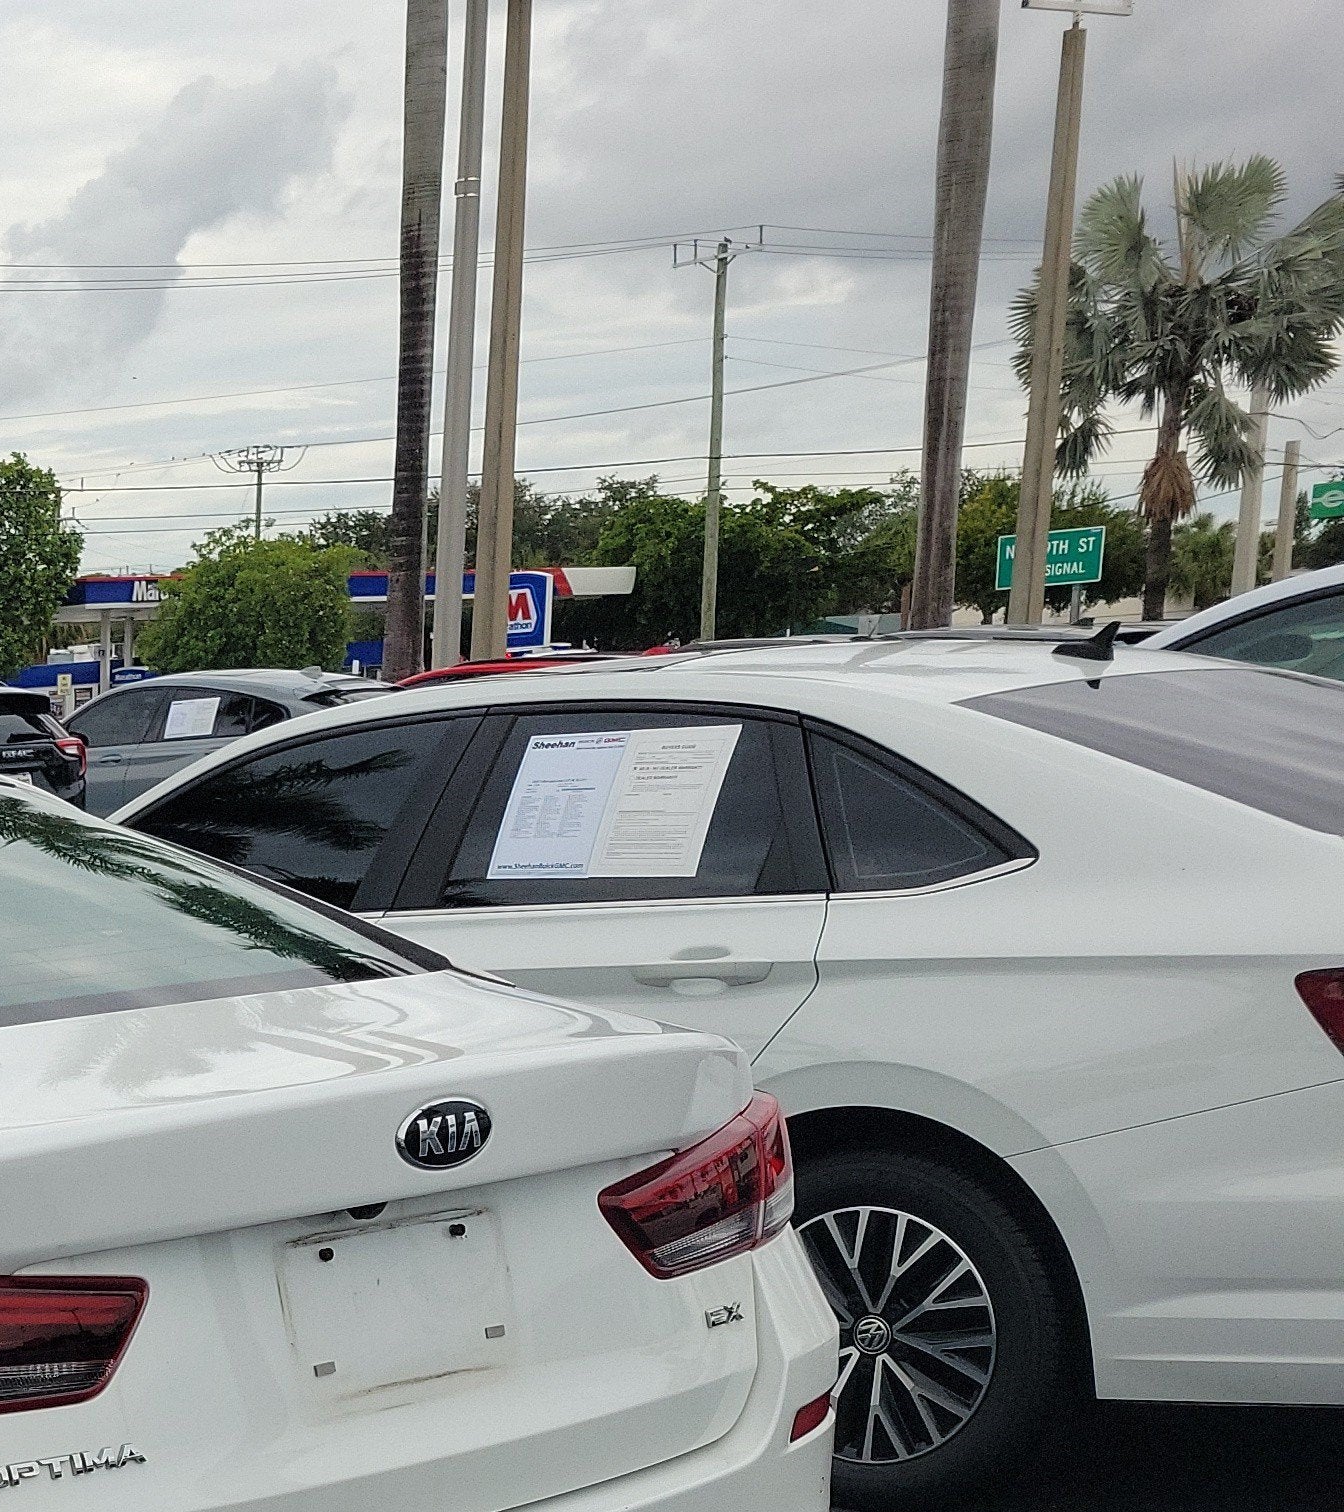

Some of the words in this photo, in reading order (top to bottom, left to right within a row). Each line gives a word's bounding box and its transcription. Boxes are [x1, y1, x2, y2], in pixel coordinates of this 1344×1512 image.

[1005, 545, 1016, 560] N
[1046, 540, 1069, 556] TH
[1078, 537, 1096, 553] ST
[1044, 562, 1086, 577] SIGNAL
[508, 621, 532, 631] athon
[532, 740, 576, 750] Sheehan
[416, 1111, 481, 1158] KIA
[704, 1301, 744, 1328] EX
